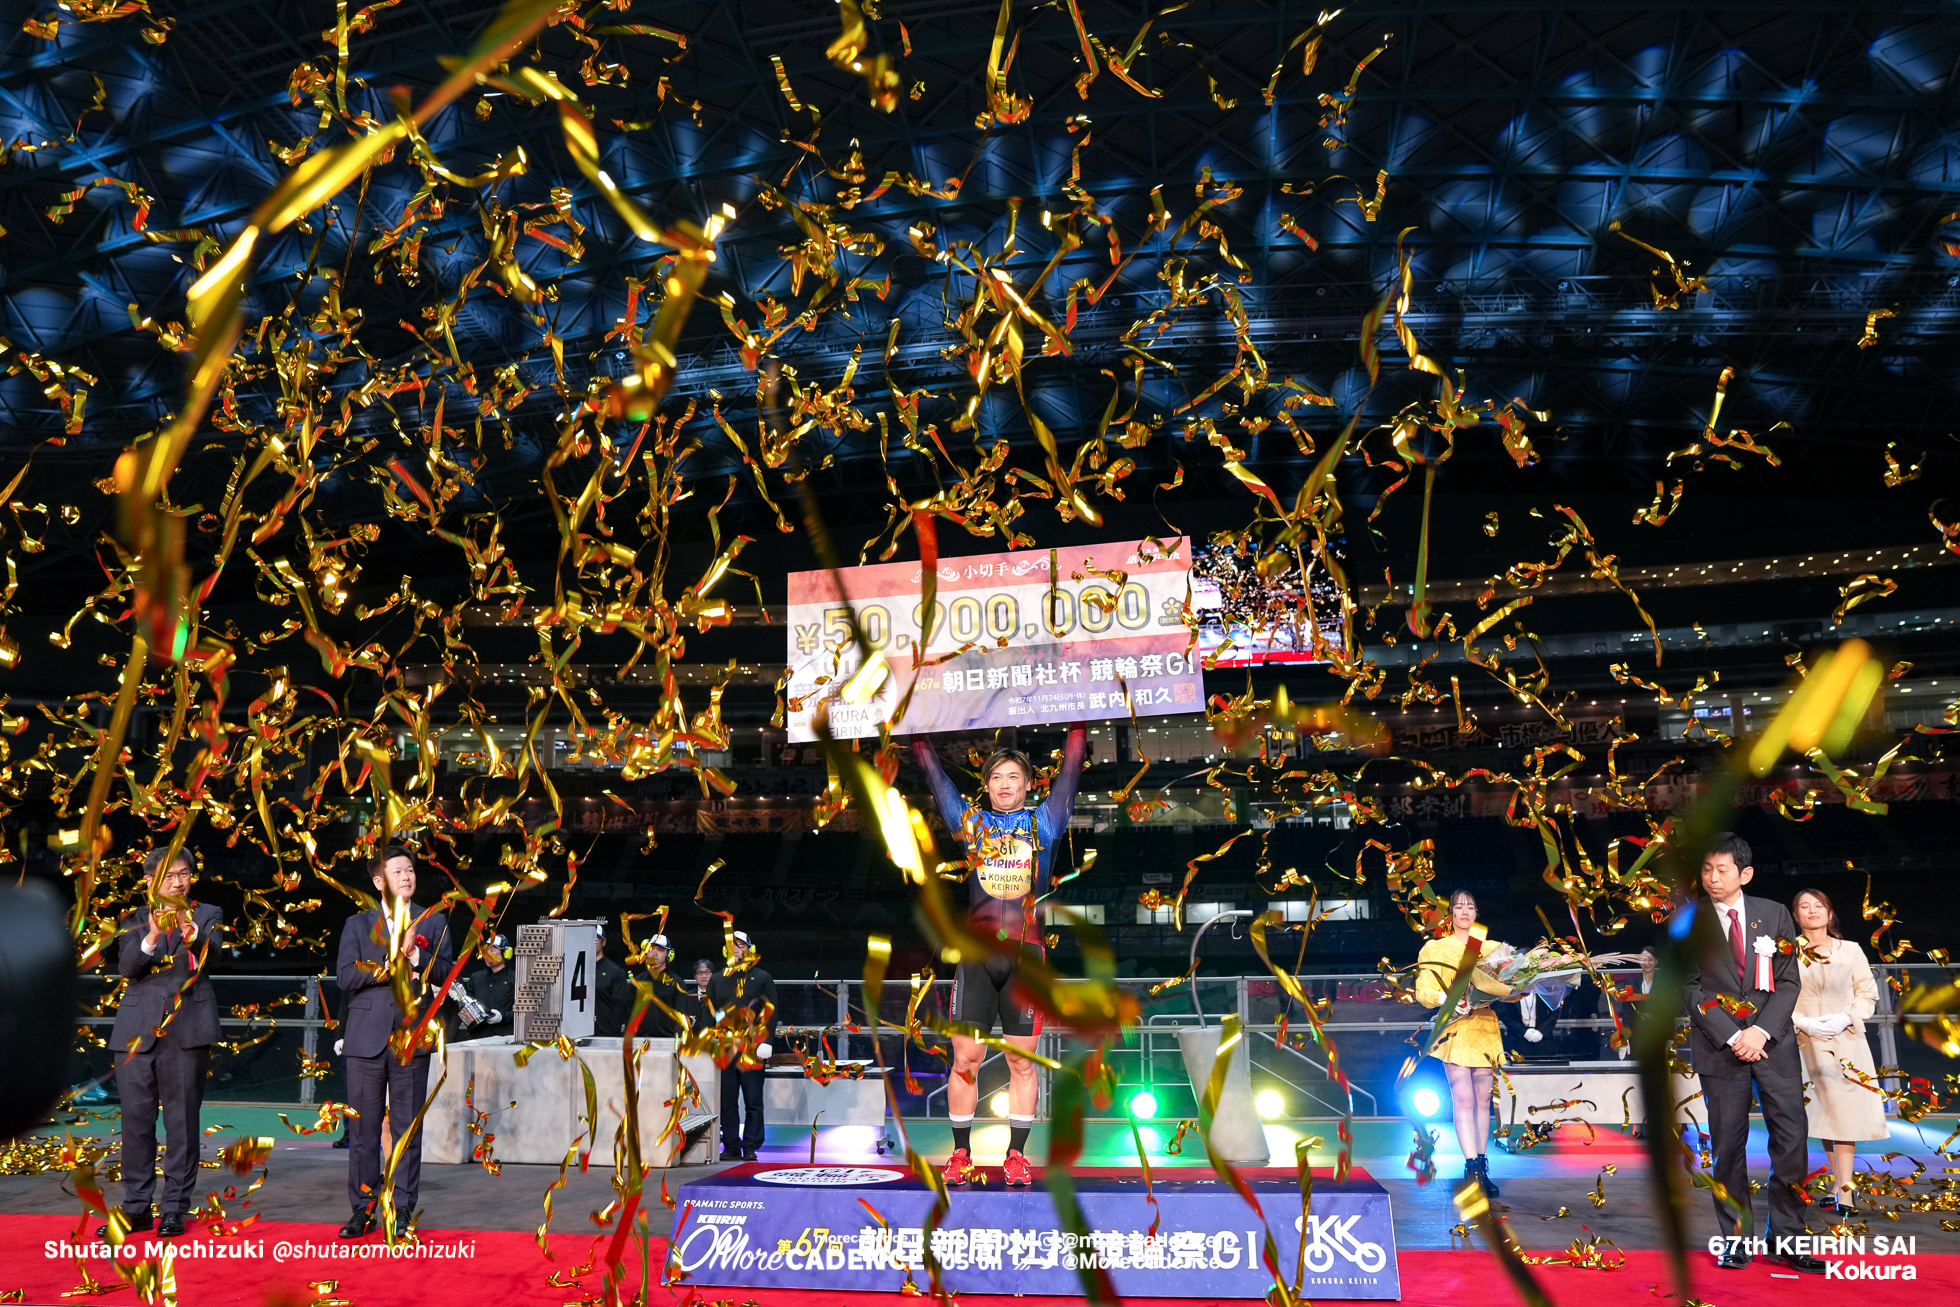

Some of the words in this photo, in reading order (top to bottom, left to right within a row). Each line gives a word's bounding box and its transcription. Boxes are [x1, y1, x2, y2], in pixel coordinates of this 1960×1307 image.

[962, 563, 1009, 579] 小切手
[942, 661, 1082, 693] 朝日新聞社杯
[1090, 650, 1196, 682] 競輪祭GI
[1008, 706, 1036, 716] 振出人
[1040, 702, 1086, 714] 北九州市長
[1135, 687, 1173, 706] 和久
[829, 725, 863, 738] EIRIN
[989, 873, 1023, 883] KOKURA
[991, 883, 1020, 891] KEIRIN
[570, 950, 587, 1013] 4
[684, 1199, 728, 1208] DRAMATIC
[729, 1201, 765, 1210] SPORTS.
[697, 1214, 747, 1225] KEIRIN
[1311, 1277, 1344, 1285] KOKURA
[1348, 1277, 1378, 1285] KEIRIN
